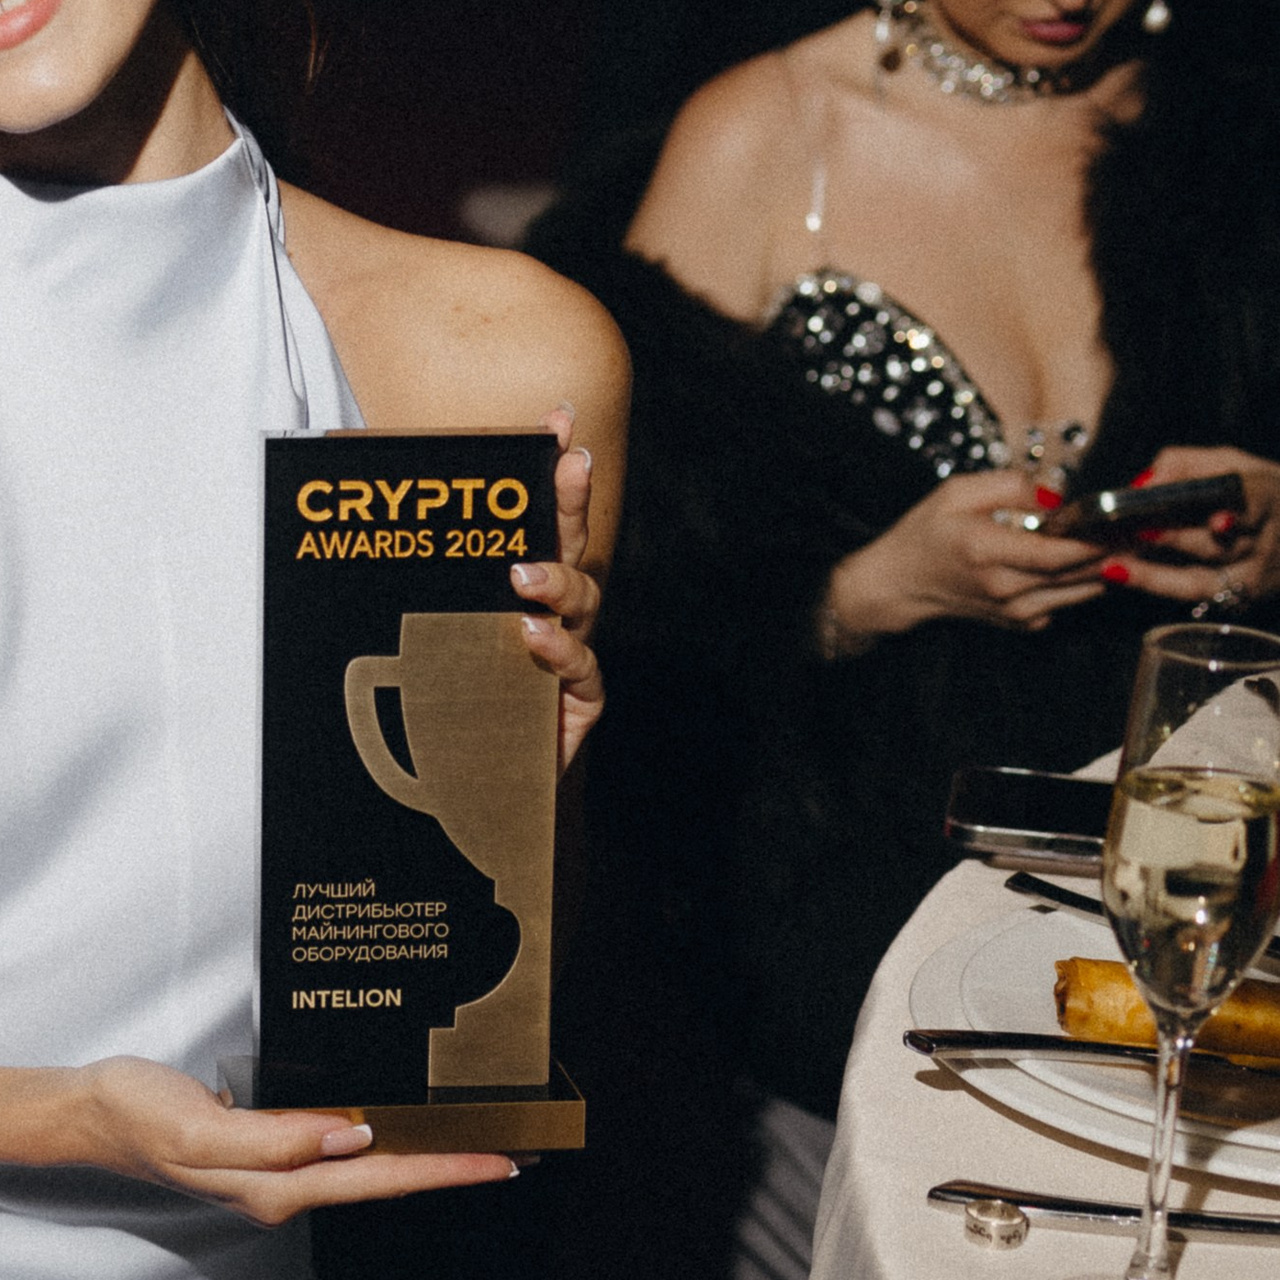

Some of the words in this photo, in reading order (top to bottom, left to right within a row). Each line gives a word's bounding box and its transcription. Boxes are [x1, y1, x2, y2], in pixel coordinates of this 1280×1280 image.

[296, 478, 529, 522] CRYPTO
[296, 529, 434, 559] AWARDS
[445, 528, 528, 557] 2024
[293, 878, 376, 899] ЛУЧШИЙ
[291, 902, 447, 922] ДИСТРИБЬЮТЕР
[292, 922, 449, 941] МАЙНИНГОВОГО
[292, 944, 448, 963] ОБОРУДОВАНИЯ
[292, 989, 402, 1009] INTELION
